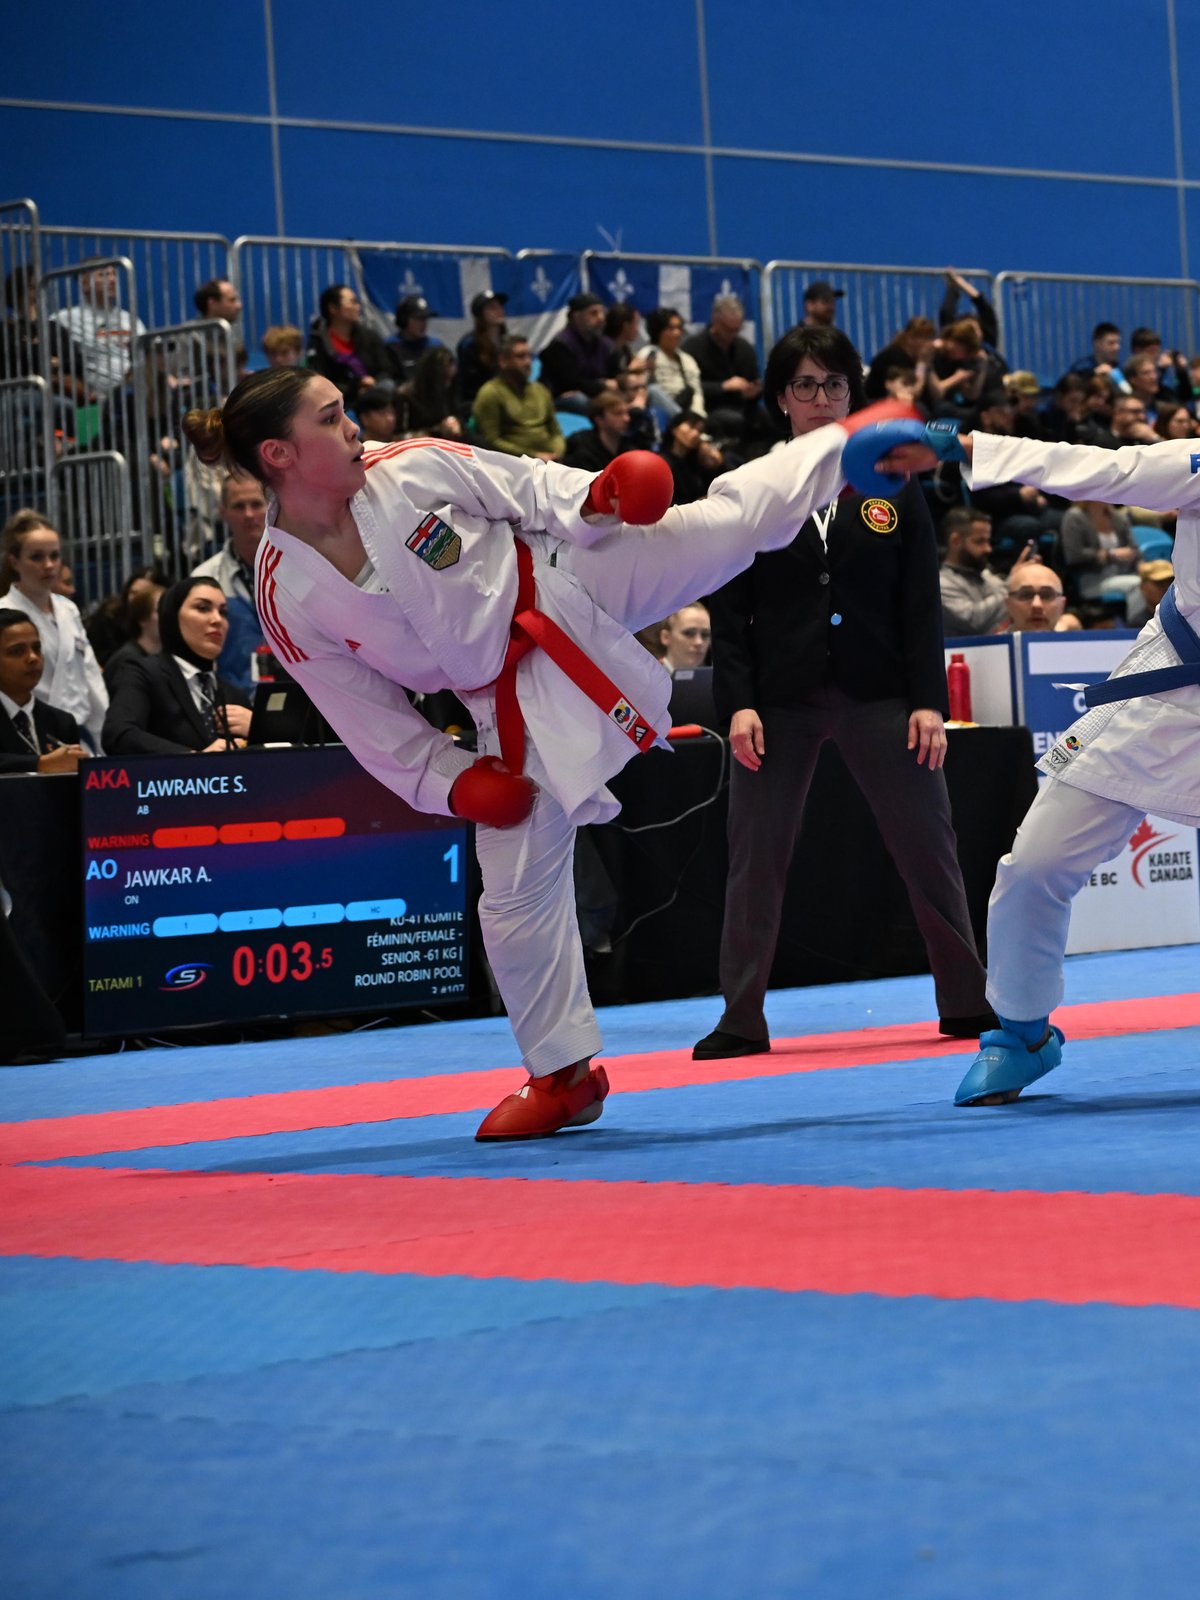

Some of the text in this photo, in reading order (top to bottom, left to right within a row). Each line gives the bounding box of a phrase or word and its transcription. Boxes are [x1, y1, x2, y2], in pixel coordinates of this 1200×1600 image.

[85, 769, 130, 790] AKA
[138, 775, 247, 798] LAWRANCE S.
[137, 805, 149, 815] AB
[87, 834, 149, 848] WARNING
[443, 844, 458, 882] 1
[1148, 851, 1191, 867] KARATE
[86, 859, 118, 880] AO
[124, 866, 212, 888] JAWKAR A.
[1149, 867, 1193, 883] CANADA
[1101, 872, 1118, 886] BC
[124, 895, 139, 905] ON
[89, 922, 150, 939] WARNING
[367, 928, 455, 947] FÉMININ/FEMALE
[381, 951, 421, 965] SENIOR
[442, 947, 457, 960] KG
[89, 976, 142, 992] TATAMI 1
[355, 966, 462, 987] ROUND ROBIN POOL
